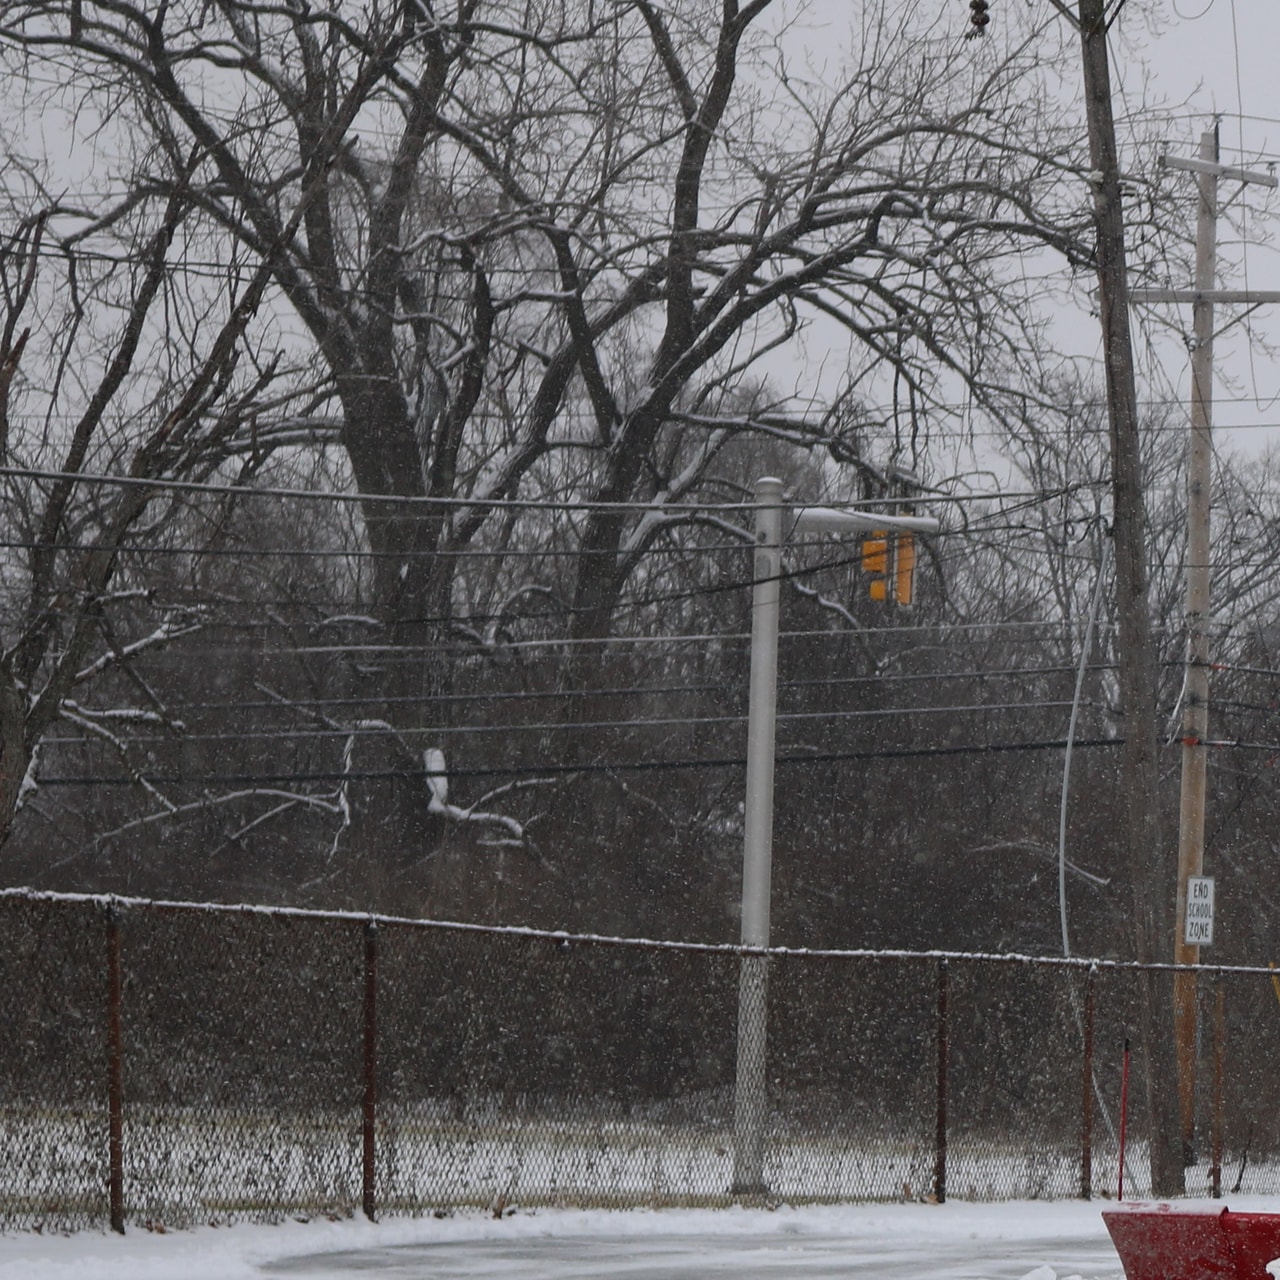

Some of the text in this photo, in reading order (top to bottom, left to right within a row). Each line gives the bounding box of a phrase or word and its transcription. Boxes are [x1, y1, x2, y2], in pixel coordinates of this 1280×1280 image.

[1193, 882, 1209, 899] END
[1188, 903, 1212, 918] SCHOOL
[1189, 922, 1209, 939] ZONE
